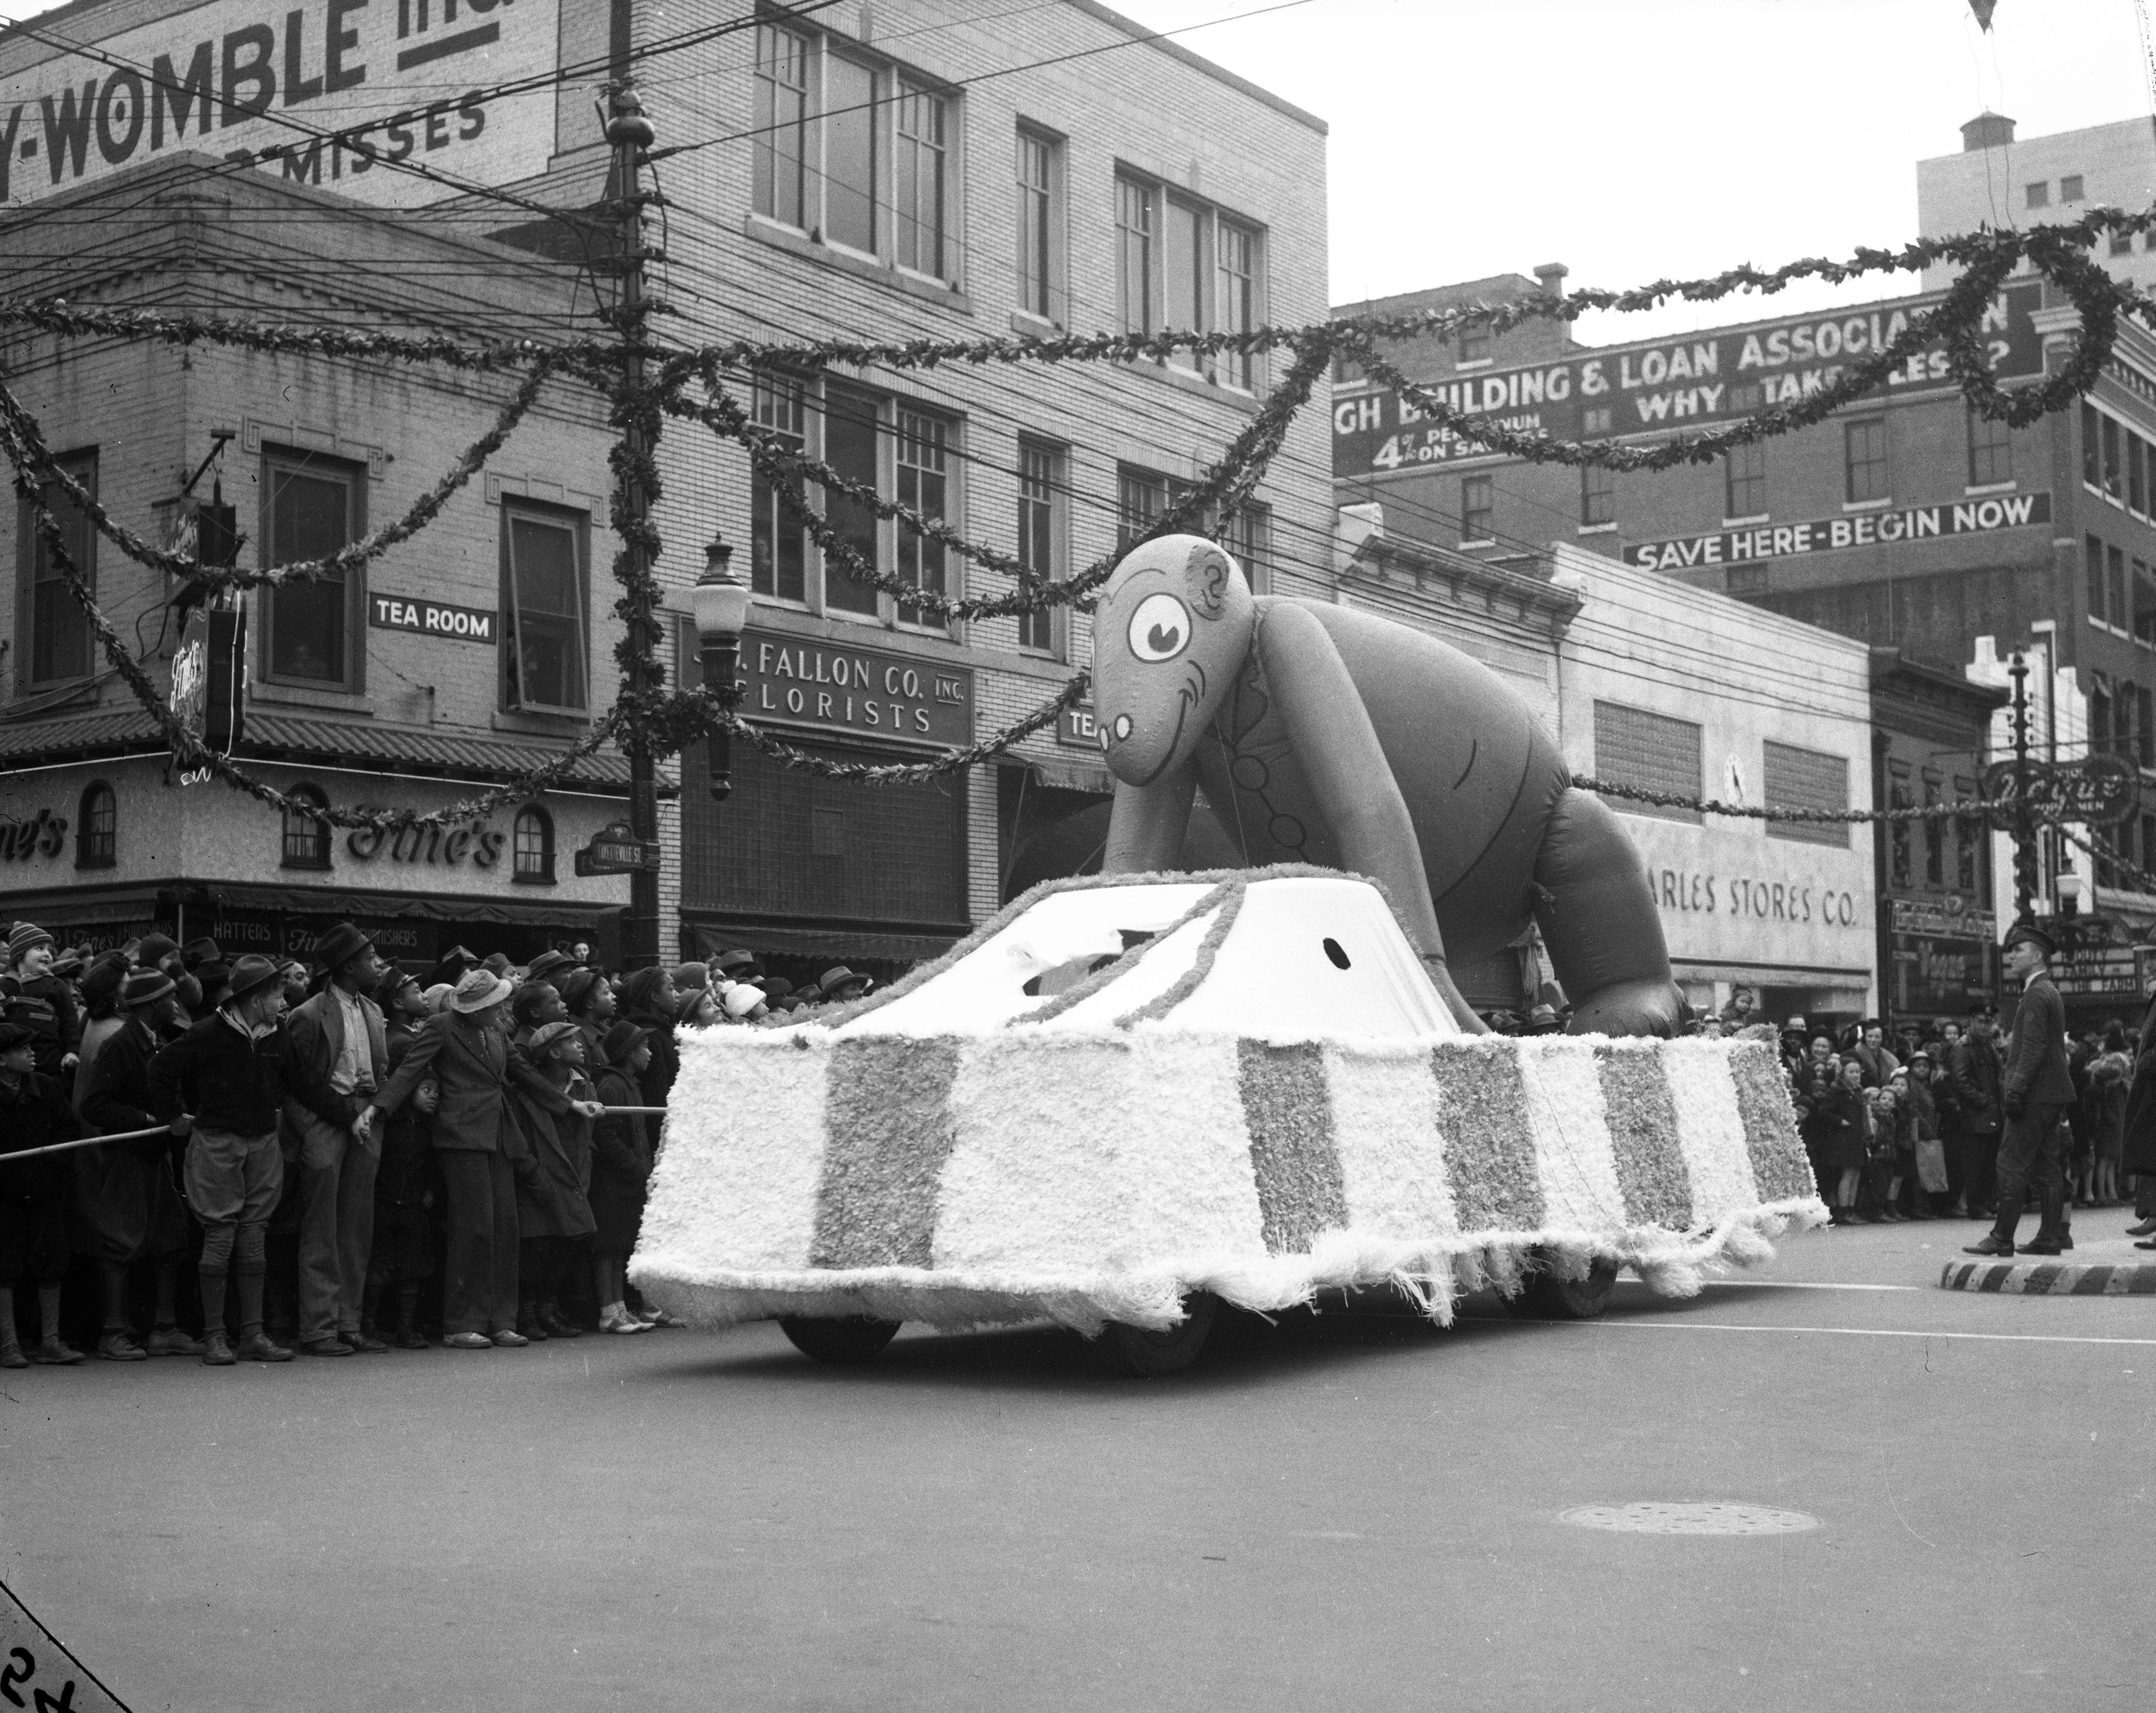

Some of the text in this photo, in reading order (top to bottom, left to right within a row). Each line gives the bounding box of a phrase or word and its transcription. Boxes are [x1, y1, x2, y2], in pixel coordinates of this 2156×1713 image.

[283, 90, 485, 185] MISSES
[1580, 360, 1610, 396] &
[1620, 341, 1719, 389] LOAN
[1737, 293, 2009, 372] ASSOCIAN
[1636, 383, 1724, 423] WHY
[1418, 444, 1446, 461] ON
[1635, 536, 1722, 571] SAVE
[1953, 495, 2034, 531] NOW
[377, 600, 489, 637] TEA ROOM
[759, 642, 870, 689] FALLON
[884, 666, 925, 699] CO.
[1069, 711, 1097, 738] TE
[1730, 879, 1811, 922] STORES
[1823, 890, 1858, 927] CO.
[213, 922, 271, 941] HATTERS
